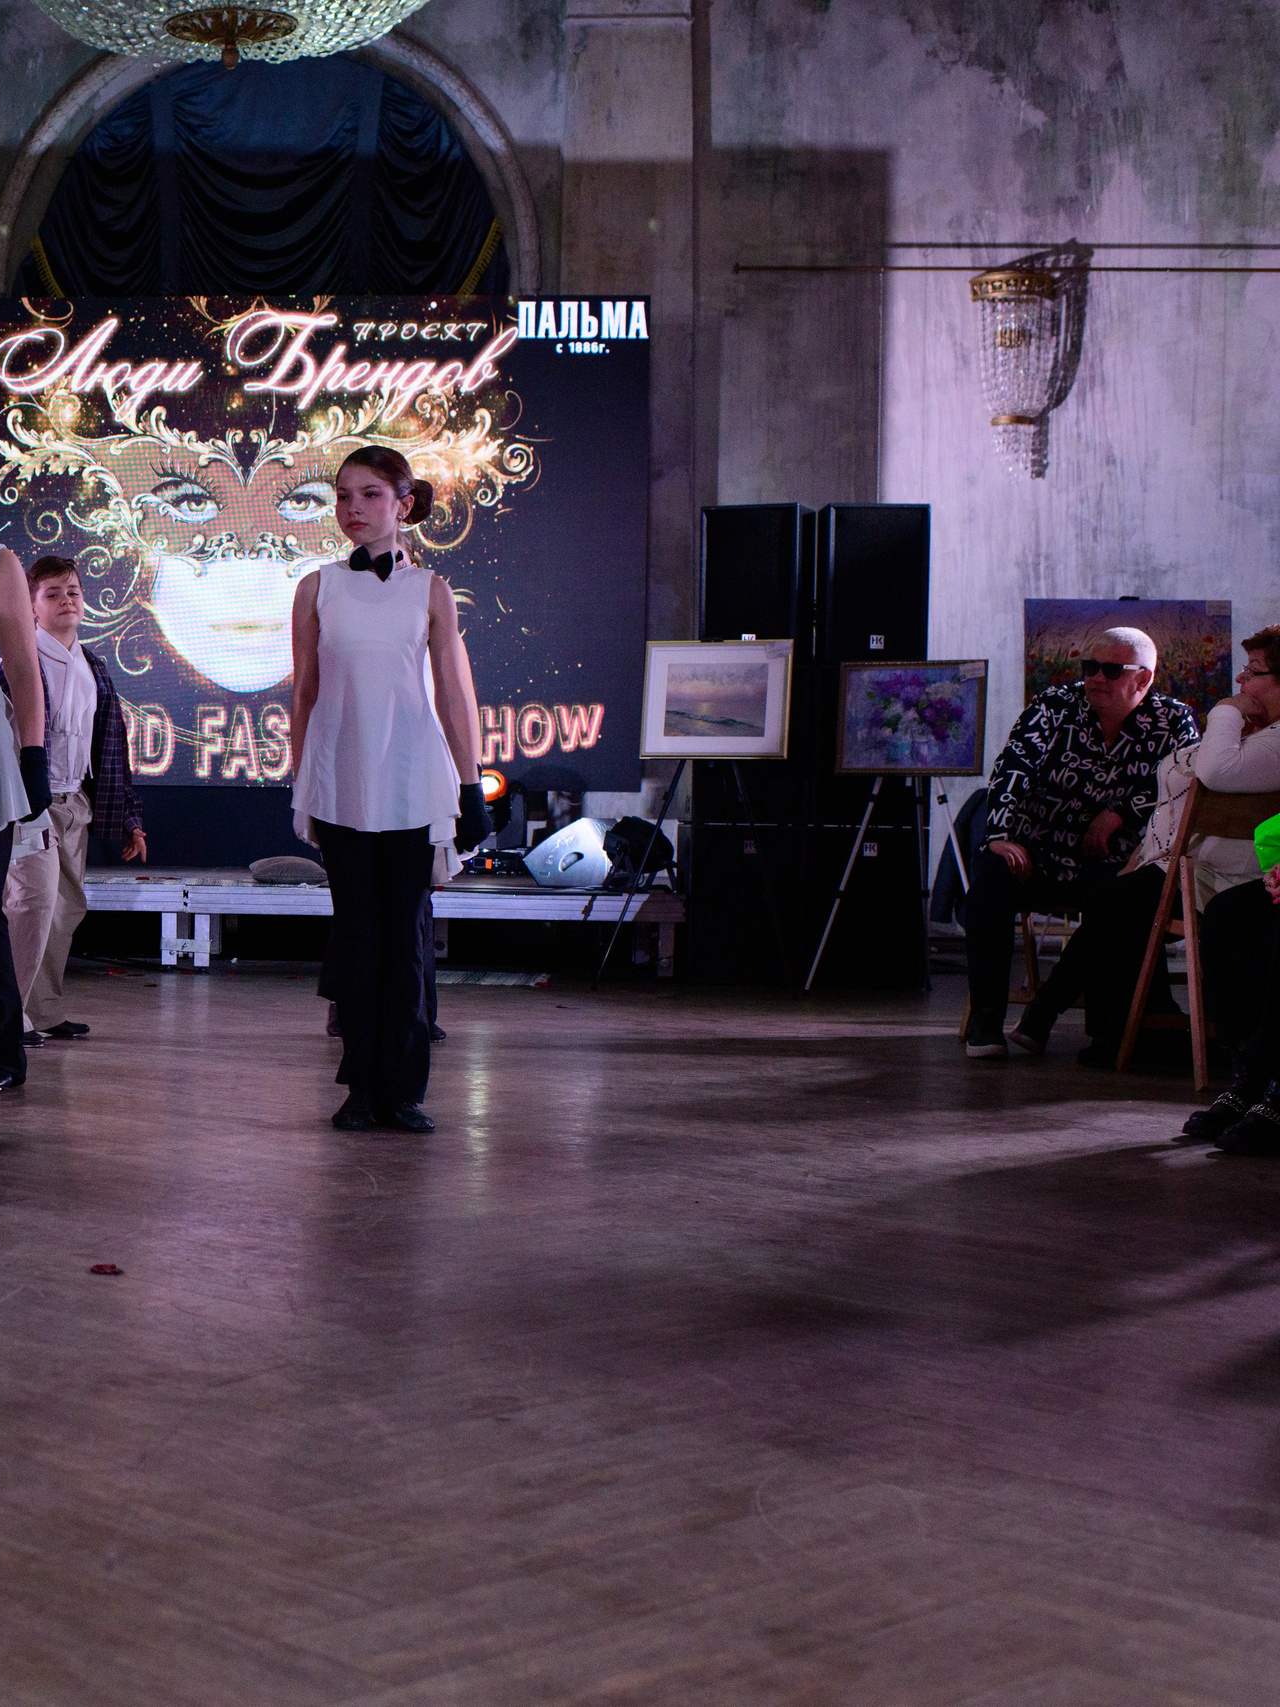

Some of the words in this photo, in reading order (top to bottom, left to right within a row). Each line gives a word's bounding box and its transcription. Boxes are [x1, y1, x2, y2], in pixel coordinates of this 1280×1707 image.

[353, 322, 488, 342] ПРОЕКТ
[518, 301, 649, 339] ПАЛЬМА
[225, 309, 519, 422] Брендов
[568, 341, 611, 355] 1886г.
[479, 702, 606, 764] HOW
